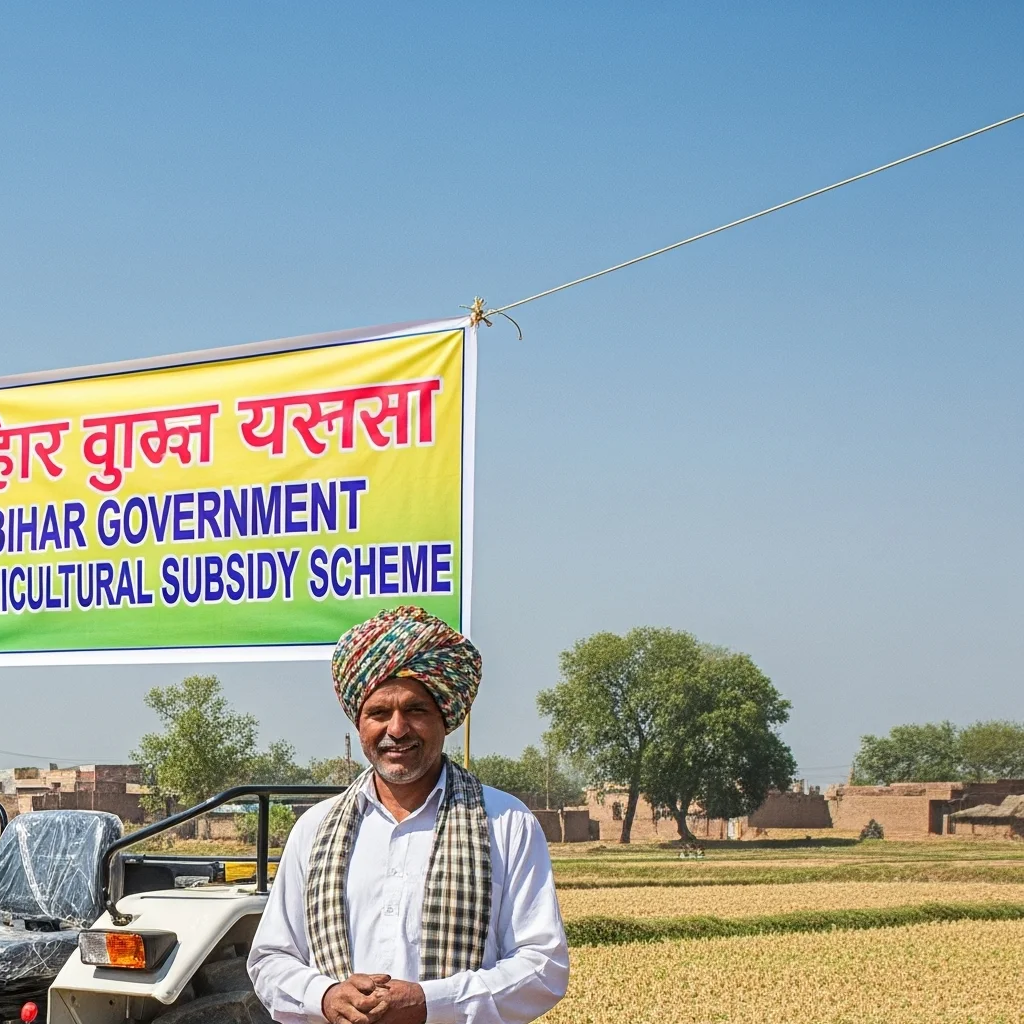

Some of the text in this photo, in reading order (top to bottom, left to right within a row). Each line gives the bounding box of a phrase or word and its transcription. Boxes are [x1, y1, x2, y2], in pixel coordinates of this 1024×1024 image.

[97, 479, 366, 546] GOVERNMENT
[162, 550, 299, 604] SUBSIDY
[310, 544, 451, 597] SCHEME
